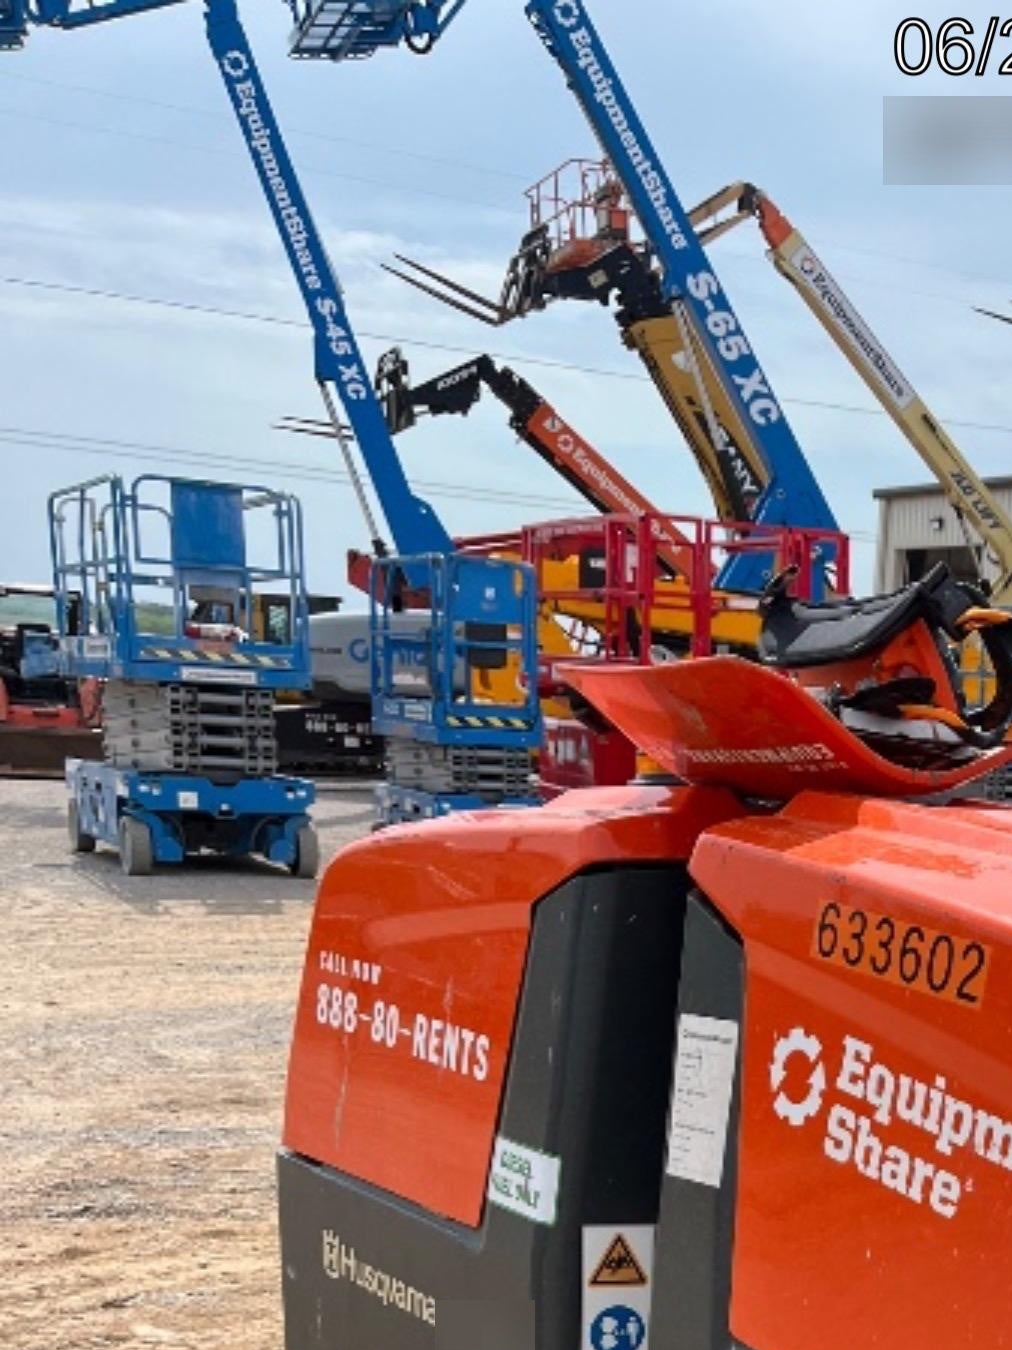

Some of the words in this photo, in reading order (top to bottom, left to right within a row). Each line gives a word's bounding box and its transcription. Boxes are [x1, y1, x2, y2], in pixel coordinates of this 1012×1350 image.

[234, 80, 322, 289] EquipmentShare
[315, 297, 353, 356] S-45
[338, 362, 367, 400] XC
[569, 26, 688, 250] EquipmentShare
[686, 271, 750, 361] S-65
[731, 368, 780, 426] XC
[351, 959, 383, 986] NOW
[816, 902, 986, 1003] 633602
[316, 983, 491, 1082] 888-80-RENTS
[823, 1103, 961, 1219] Share
[341, 1243, 436, 1328] Husqvarna
